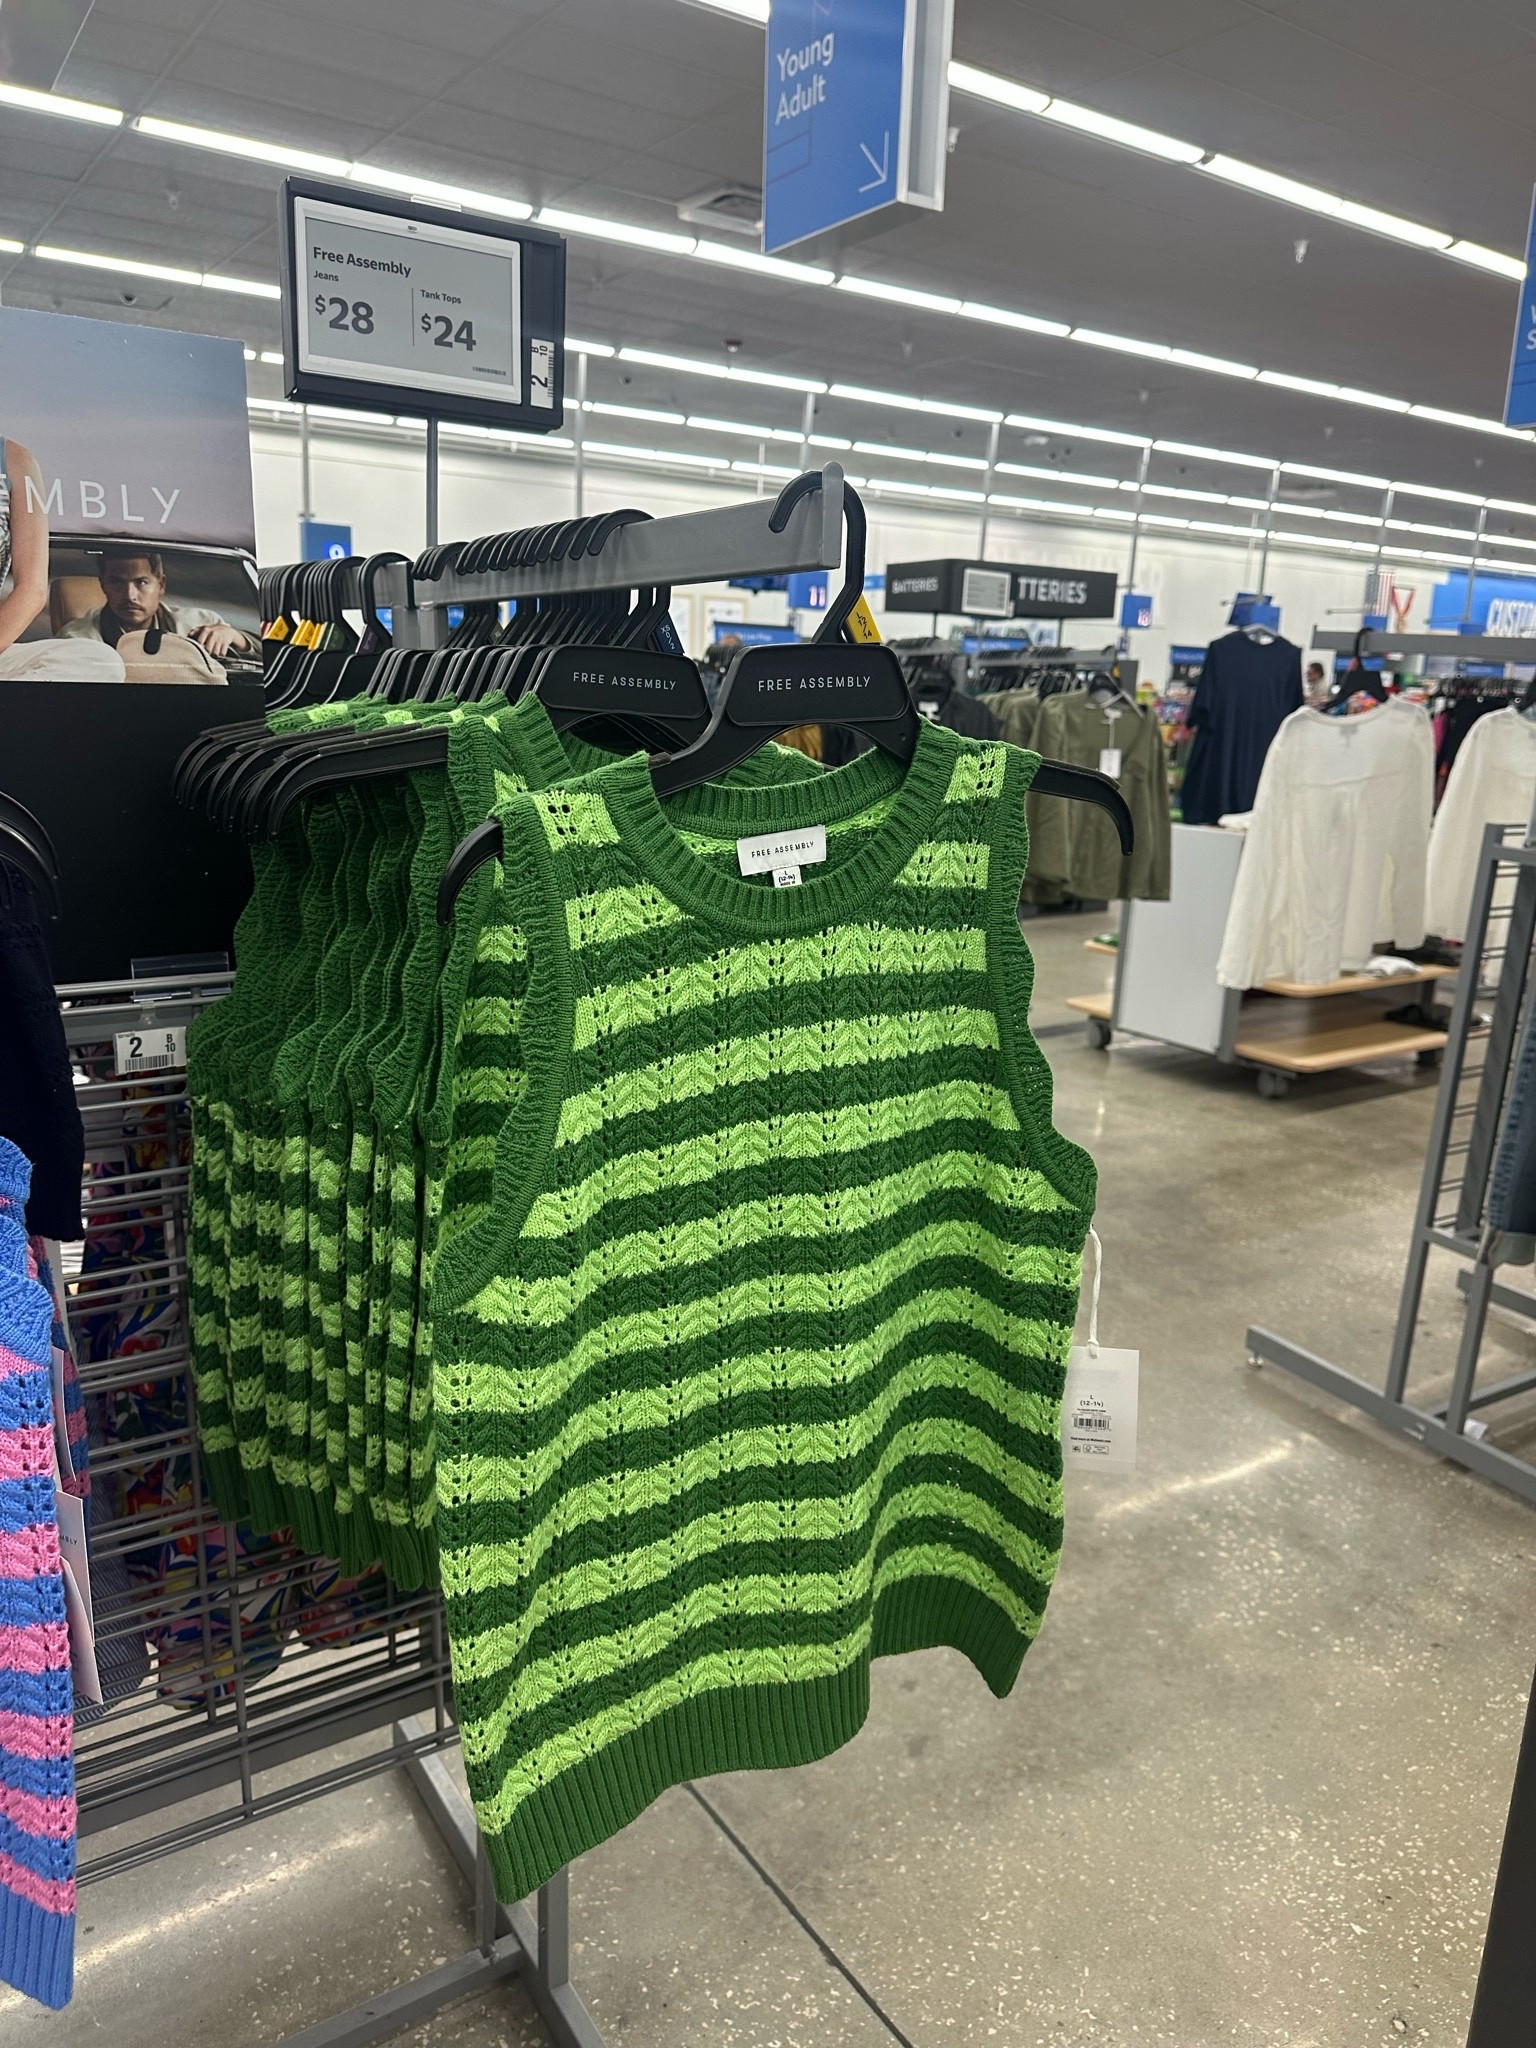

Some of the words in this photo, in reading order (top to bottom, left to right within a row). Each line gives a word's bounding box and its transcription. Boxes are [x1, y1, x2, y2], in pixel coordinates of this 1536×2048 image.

[776, 32, 835, 82] Young
[774, 74, 826, 126] Adult
[313, 247, 344, 264] Free
[346, 253, 411, 278] Assembly
[313, 270, 339, 282] Jeans
[420, 289, 440, 302] Tank
[441, 292, 462, 304] Tops
[315, 294, 375, 335] $28
[421, 313, 477, 352] $24
[531, 375, 548, 388] 2
[891, 576, 939, 594] BATTERIES
[573, 671, 605, 684] FREE
[611, 676, 676, 690] ASSEMBLY
[758, 678, 792, 692] FREE
[799, 676, 871, 689] ASSEMBLY
[751, 848, 771, 858] FREE
[774, 841, 815, 854] ASSEMBLY
[129, 1036, 143, 1058] 2
[166, 1033, 173, 1043] B
[165, 1043, 176, 1053] 10
